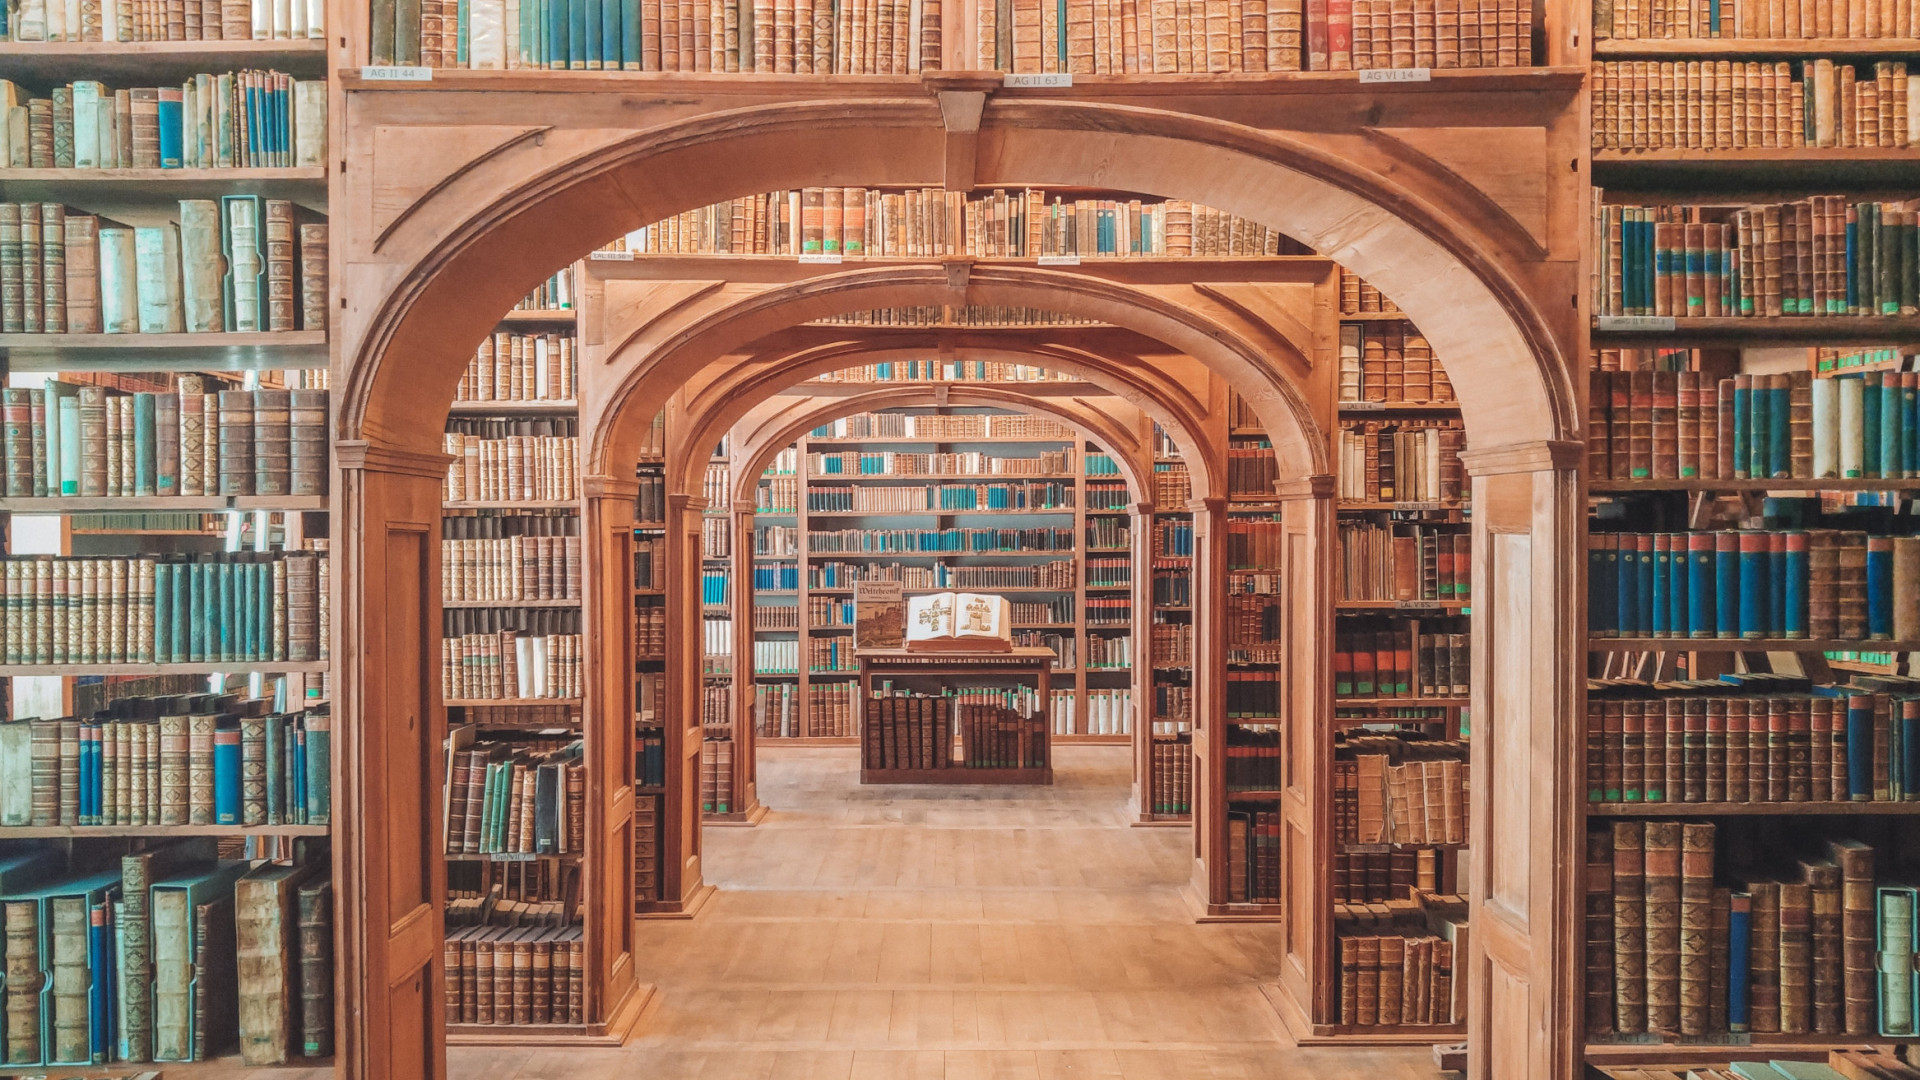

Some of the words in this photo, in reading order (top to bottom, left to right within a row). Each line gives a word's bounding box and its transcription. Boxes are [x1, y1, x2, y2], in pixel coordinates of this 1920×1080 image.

[370, 69, 386, 78] AG
[390, 69, 398, 78] II
[1366, 72, 1382, 80] AG
[1385, 71, 1396, 80] VI
[1402, 71, 1414, 79] 14
[1014, 77, 1029, 85] AG
[1033, 77, 1040, 85] II
[1045, 77, 1058, 85] 63
